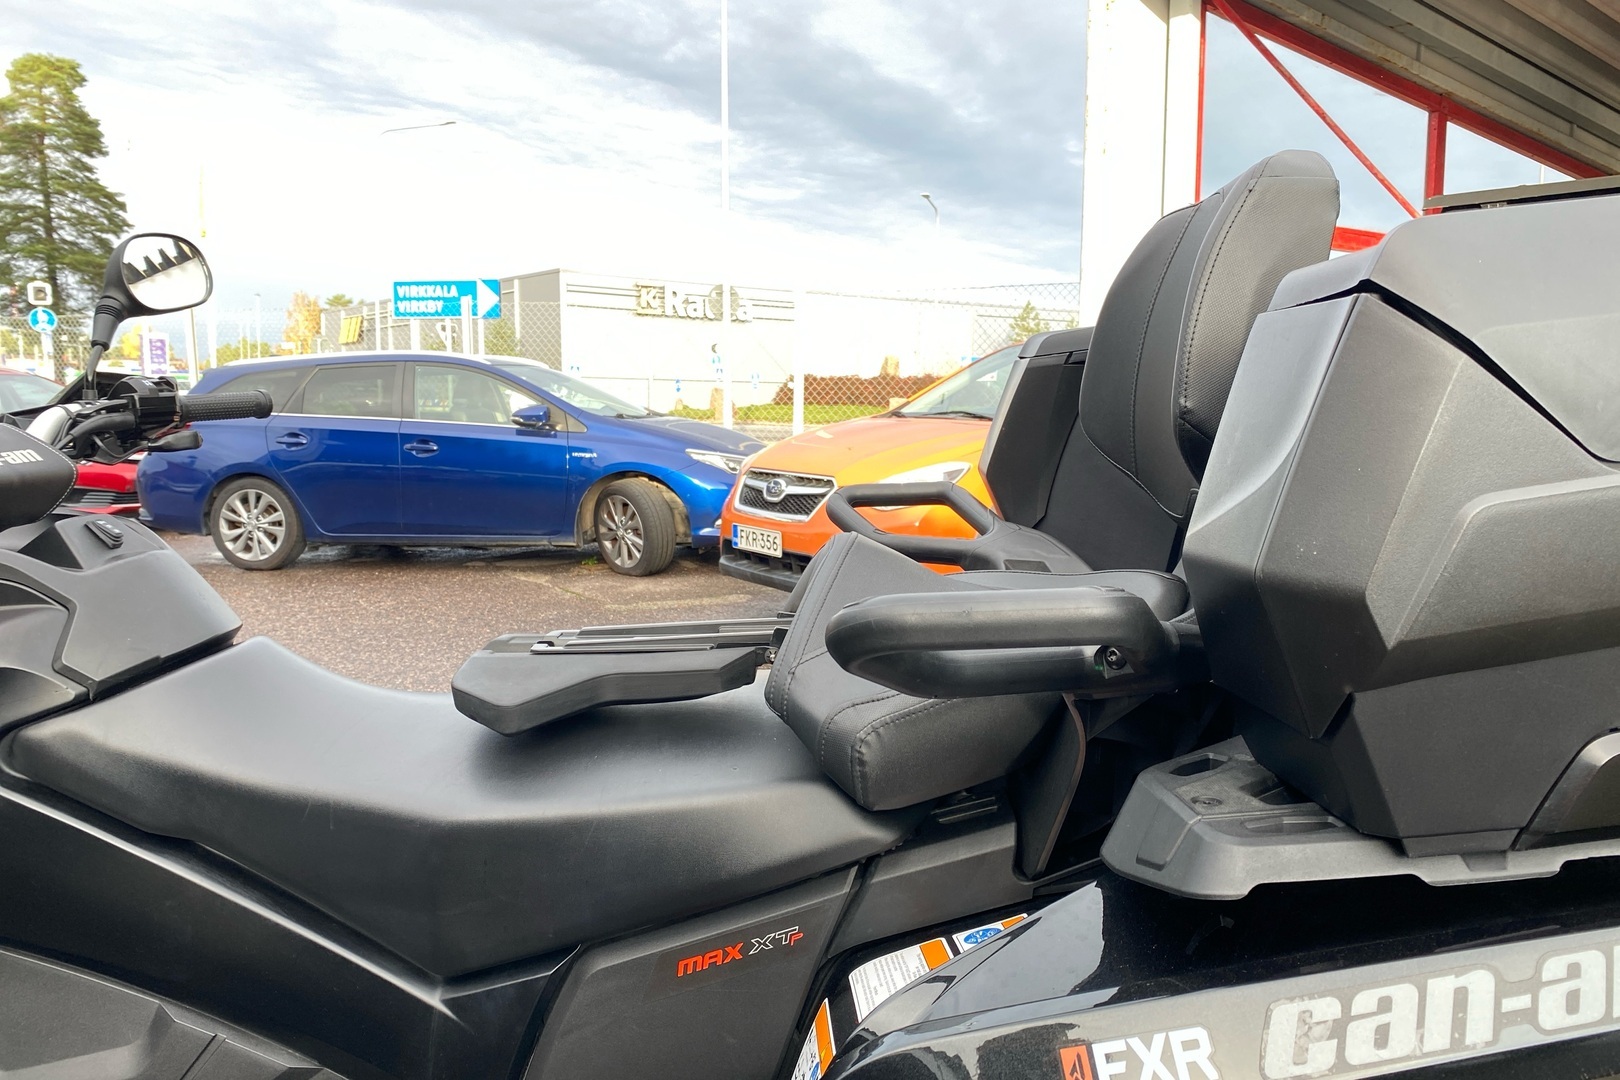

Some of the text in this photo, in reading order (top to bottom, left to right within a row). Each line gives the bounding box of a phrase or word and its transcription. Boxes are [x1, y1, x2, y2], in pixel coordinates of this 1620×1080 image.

[396, 284, 459, 298] VIRKKALA
[740, 529, 779, 552] FKR-356
[677, 942, 744, 977] MAX
[1265, 945, 1620, 1080] can-a
[1091, 1026, 1220, 1080] FXR
